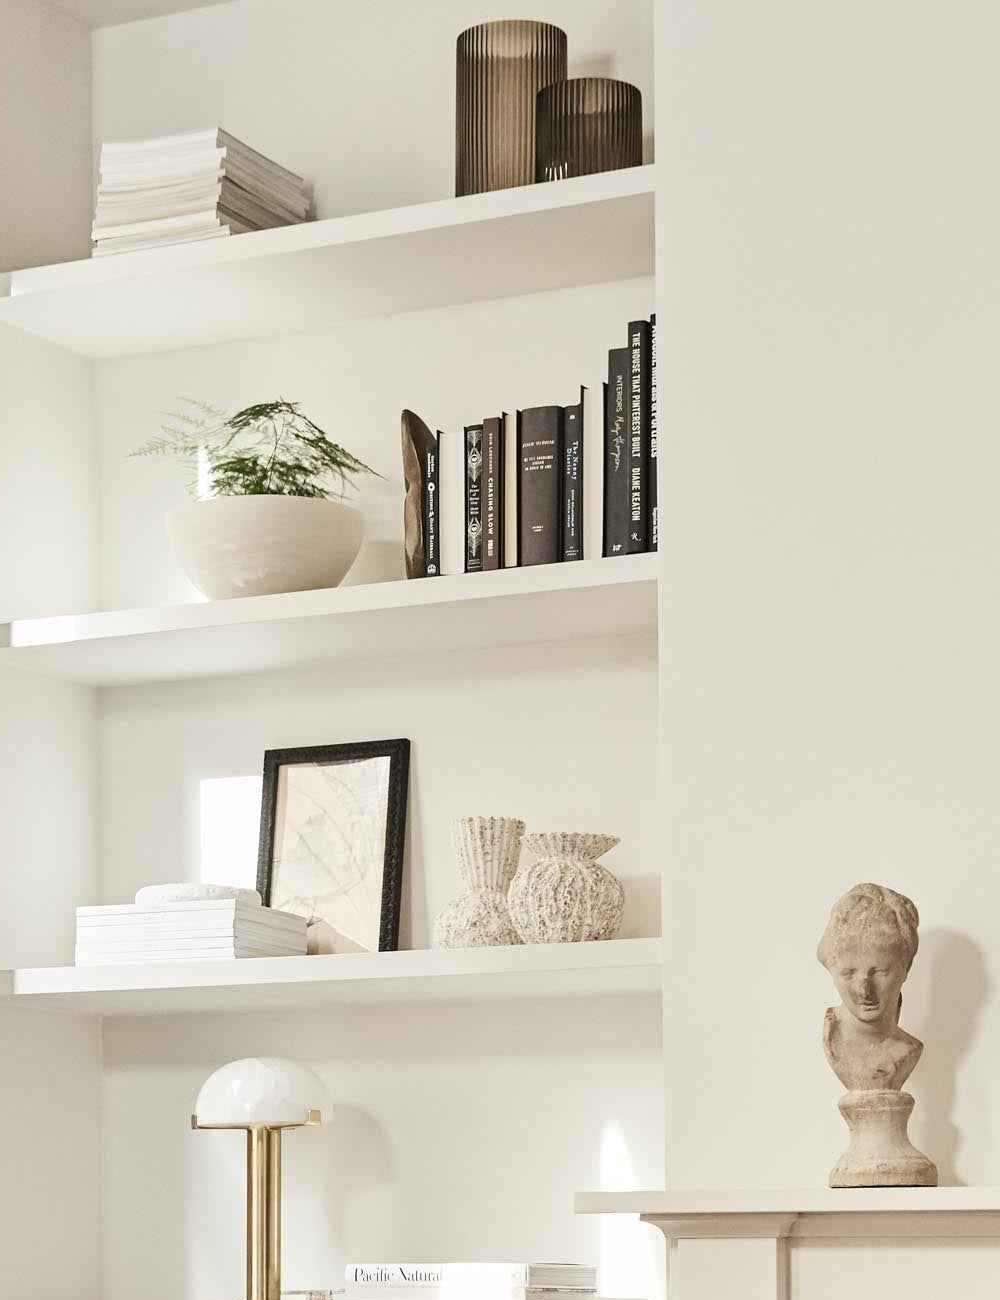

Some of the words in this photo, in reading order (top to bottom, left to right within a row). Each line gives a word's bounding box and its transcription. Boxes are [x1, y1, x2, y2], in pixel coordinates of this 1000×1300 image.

[631, 332, 641, 347] THE
[631, 348, 641, 374] HOUSE
[615, 374, 623, 413] INTERIORS
[631, 374, 641, 394] THAT
[631, 394, 641, 435] PINTEREST
[571, 440, 579, 455] The
[631, 436, 641, 458] BUILT
[631, 467, 641, 491] DIANE
[487, 478, 495, 511] CHASING
[631, 491, 641, 521] KEATON
[487, 513, 495, 535] SLOW
[353, 1265, 394, 1282] Pacific
[398, 1266, 443, 1282] Natura
